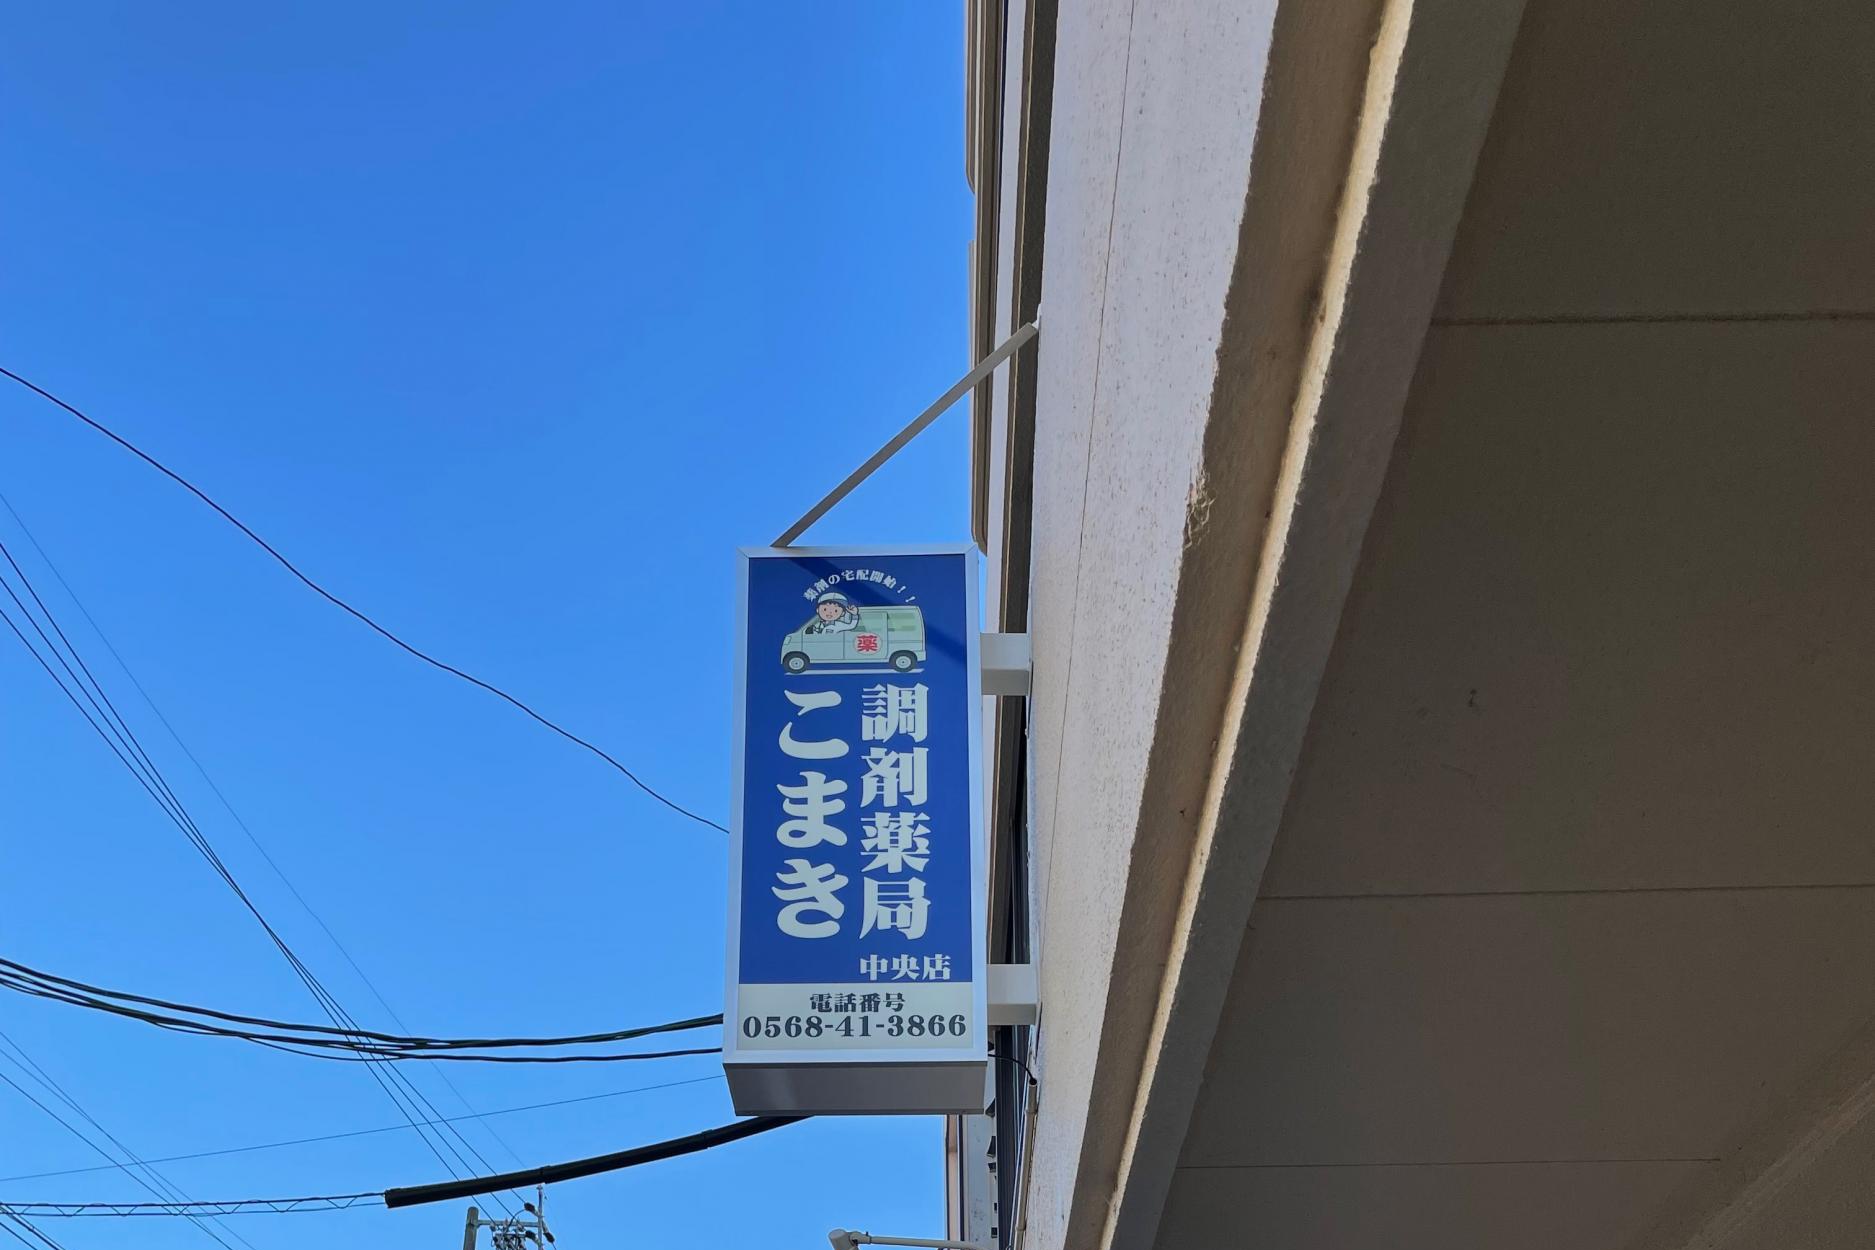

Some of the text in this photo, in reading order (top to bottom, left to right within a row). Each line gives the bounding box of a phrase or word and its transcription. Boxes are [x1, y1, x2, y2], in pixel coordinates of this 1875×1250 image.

[857, 635, 879, 652] 薬
[772, 690, 849, 938] こまき
[859, 683, 929, 940] 調剤薬局
[859, 953, 951, 981] 中央店
[810, 992, 906, 1013] 電話番号
[743, 1014, 966, 1038] 0568-41-3866
